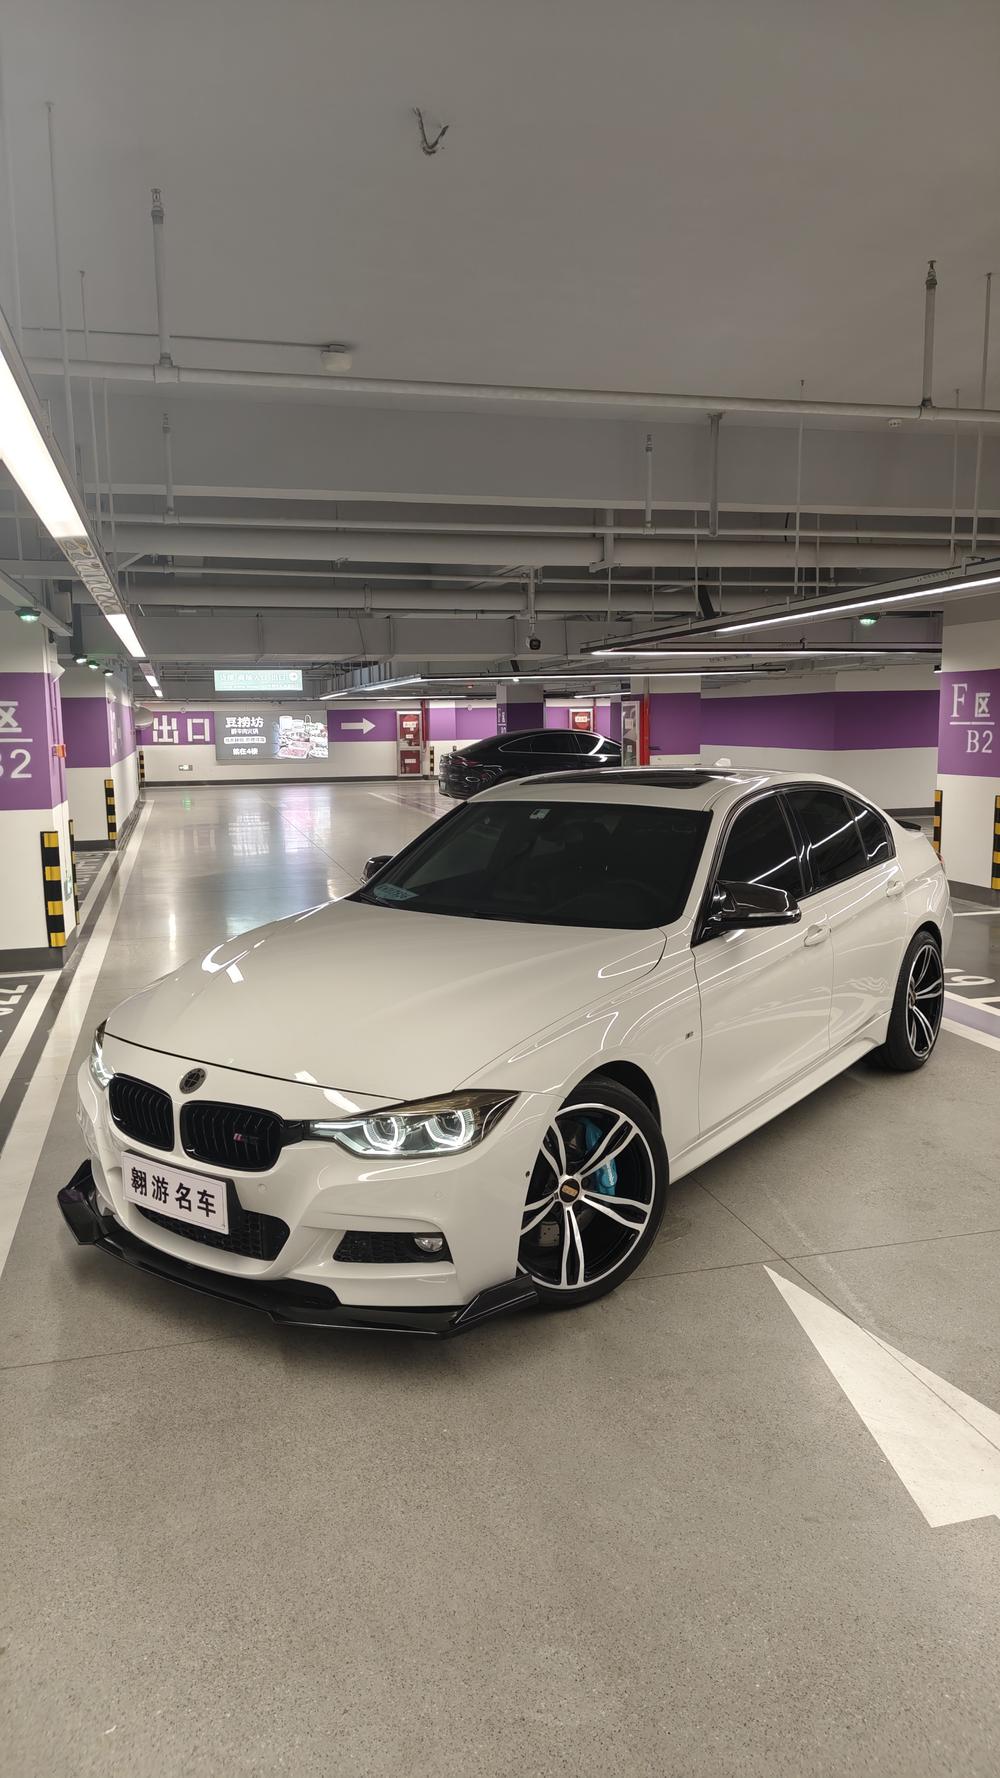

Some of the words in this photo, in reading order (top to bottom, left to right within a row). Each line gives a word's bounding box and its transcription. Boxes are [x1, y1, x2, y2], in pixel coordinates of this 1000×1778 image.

[152, 714, 210, 744] 出口
[225, 716, 264, 728] 豆捞坊
[966, 729, 993, 754] B2
[0, 748, 32, 779] 2
